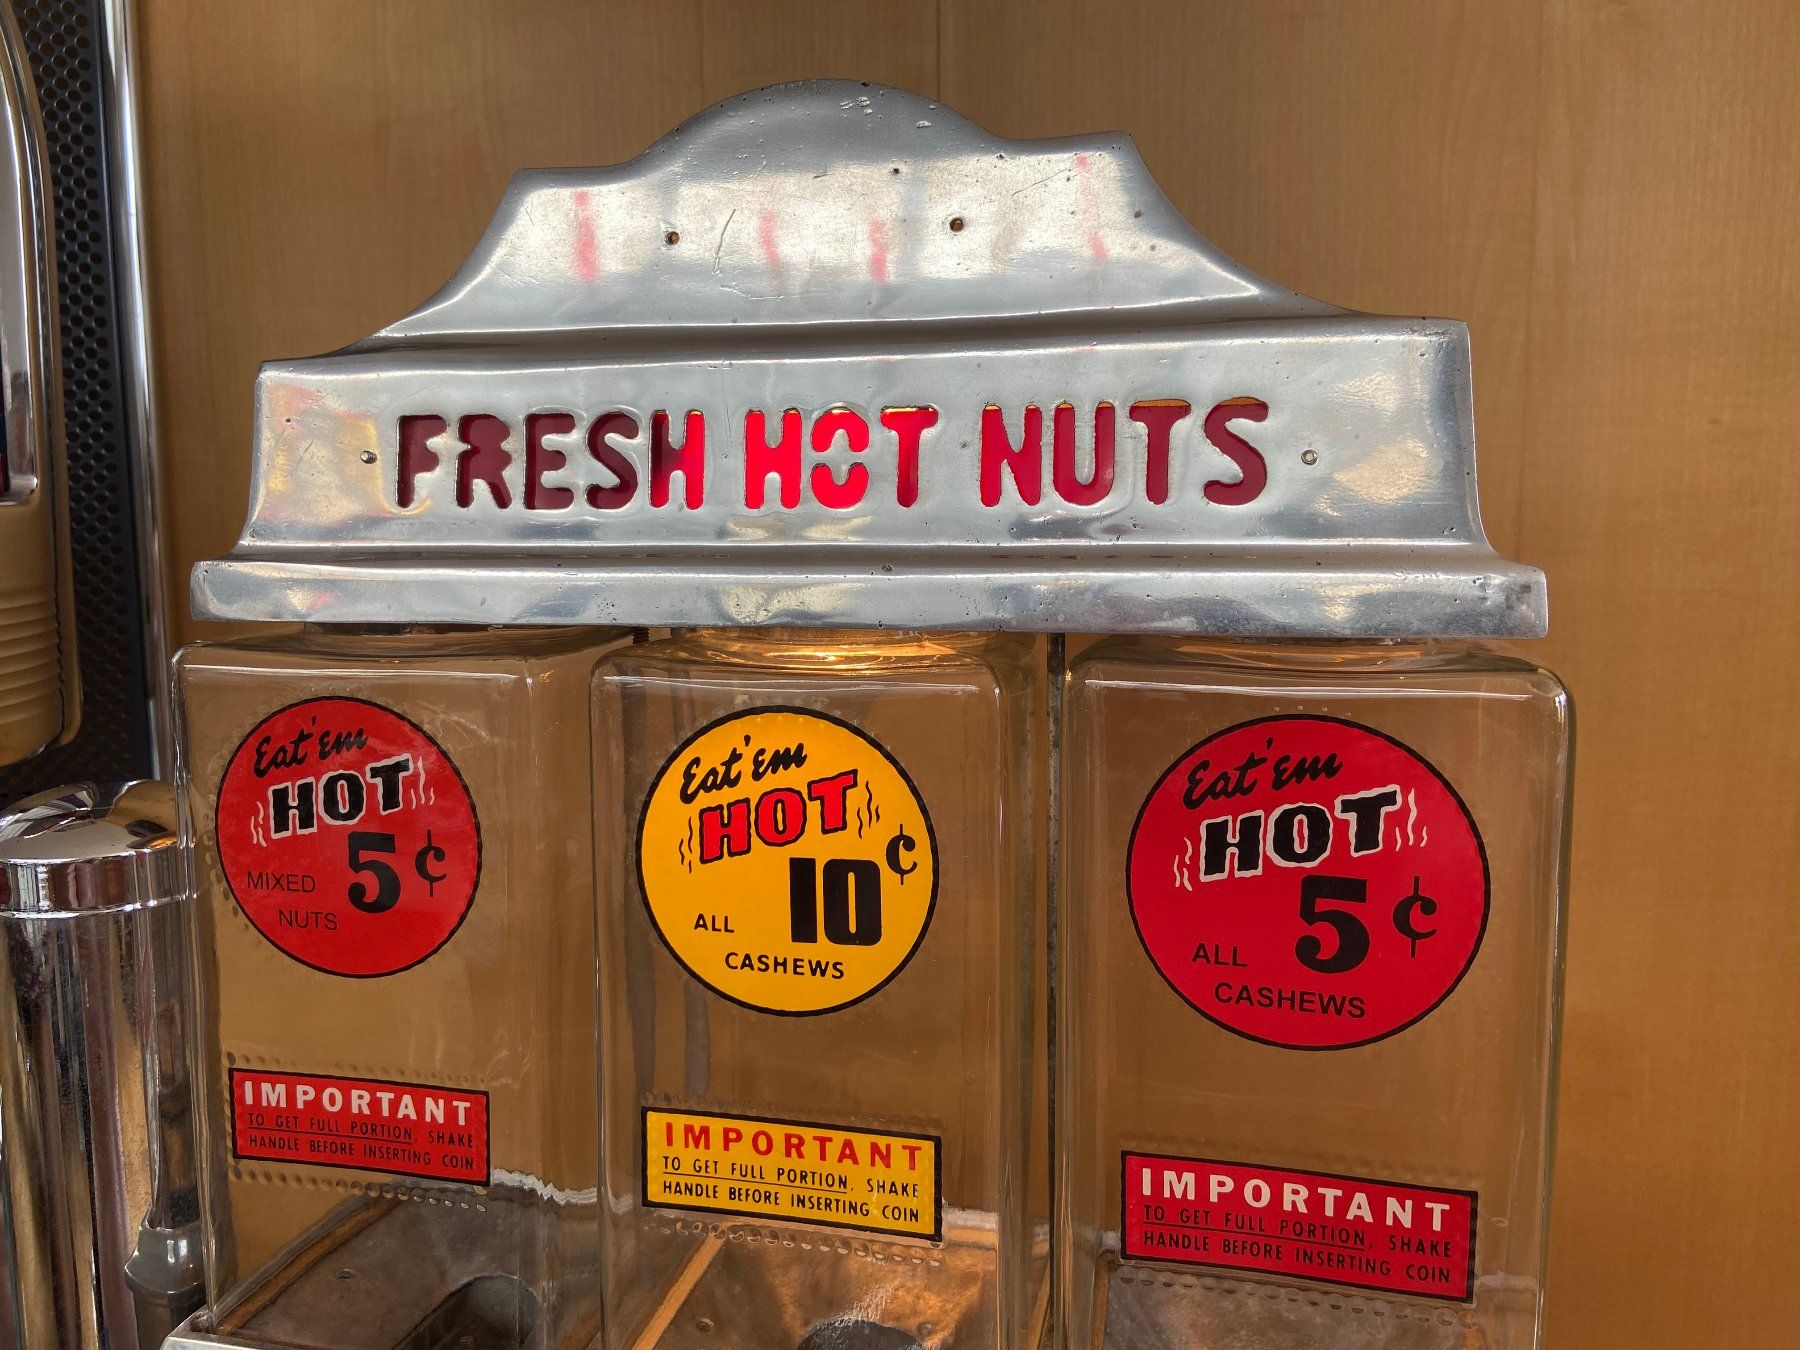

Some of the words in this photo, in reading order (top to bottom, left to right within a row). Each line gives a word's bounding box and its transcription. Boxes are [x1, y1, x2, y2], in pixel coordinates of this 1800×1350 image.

[397, 408, 705, 510] FRESH
[744, 403, 938, 509] HOT
[979, 396, 1269, 507] NUTS
[268, 753, 414, 839] HOT
[699, 768, 858, 865] HOT
[1200, 784, 1401, 882] HOT
[247, 871, 316, 893] MIXED
[279, 909, 338, 931] NUTS
[694, 913, 735, 933] ALL
[725, 952, 845, 979] CASHEWS
[1191, 943, 1248, 967] ALL
[1214, 982, 1366, 1018] CASHEWS
[244, 1081, 471, 1126] IMPORTANT
[248, 1113, 265, 1126] TO
[276, 1115, 299, 1129] GET
[310, 1118, 341, 1133] FULL
[428, 1129, 474, 1148] SHAKE
[250, 1134, 299, 1151] HANDLE
[310, 1139, 354, 1156] BEFORE
[363, 1145, 431, 1165] INSERTING
[442, 1154, 474, 1170] COIN
[665, 1122, 922, 1170] IMPORTANT
[663, 1156, 681, 1171] TO
[693, 1158, 719, 1174] GET
[731, 1162, 765, 1180] FULL
[866, 1178, 919, 1198] SHAKE
[663, 1180, 719, 1199] HANDLE
[729, 1187, 780, 1205] BEFORE
[791, 1194, 870, 1217] INSERTING
[882, 1205, 919, 1223] COIN
[1142, 1167, 1450, 1231] IMPORTANT
[1144, 1204, 1165, 1222] TO
[1180, 1207, 1210, 1226] GET
[1225, 1212, 1265, 1233] FULL
[1389, 1235, 1451, 1258] SHAKE
[1143, 1230, 1209, 1252] HANDLE
[1222, 1238, 1283, 1261] BEFORE
[1295, 1247, 1391, 1276] INSERTING
[1405, 1263, 1450, 1283] COIN
